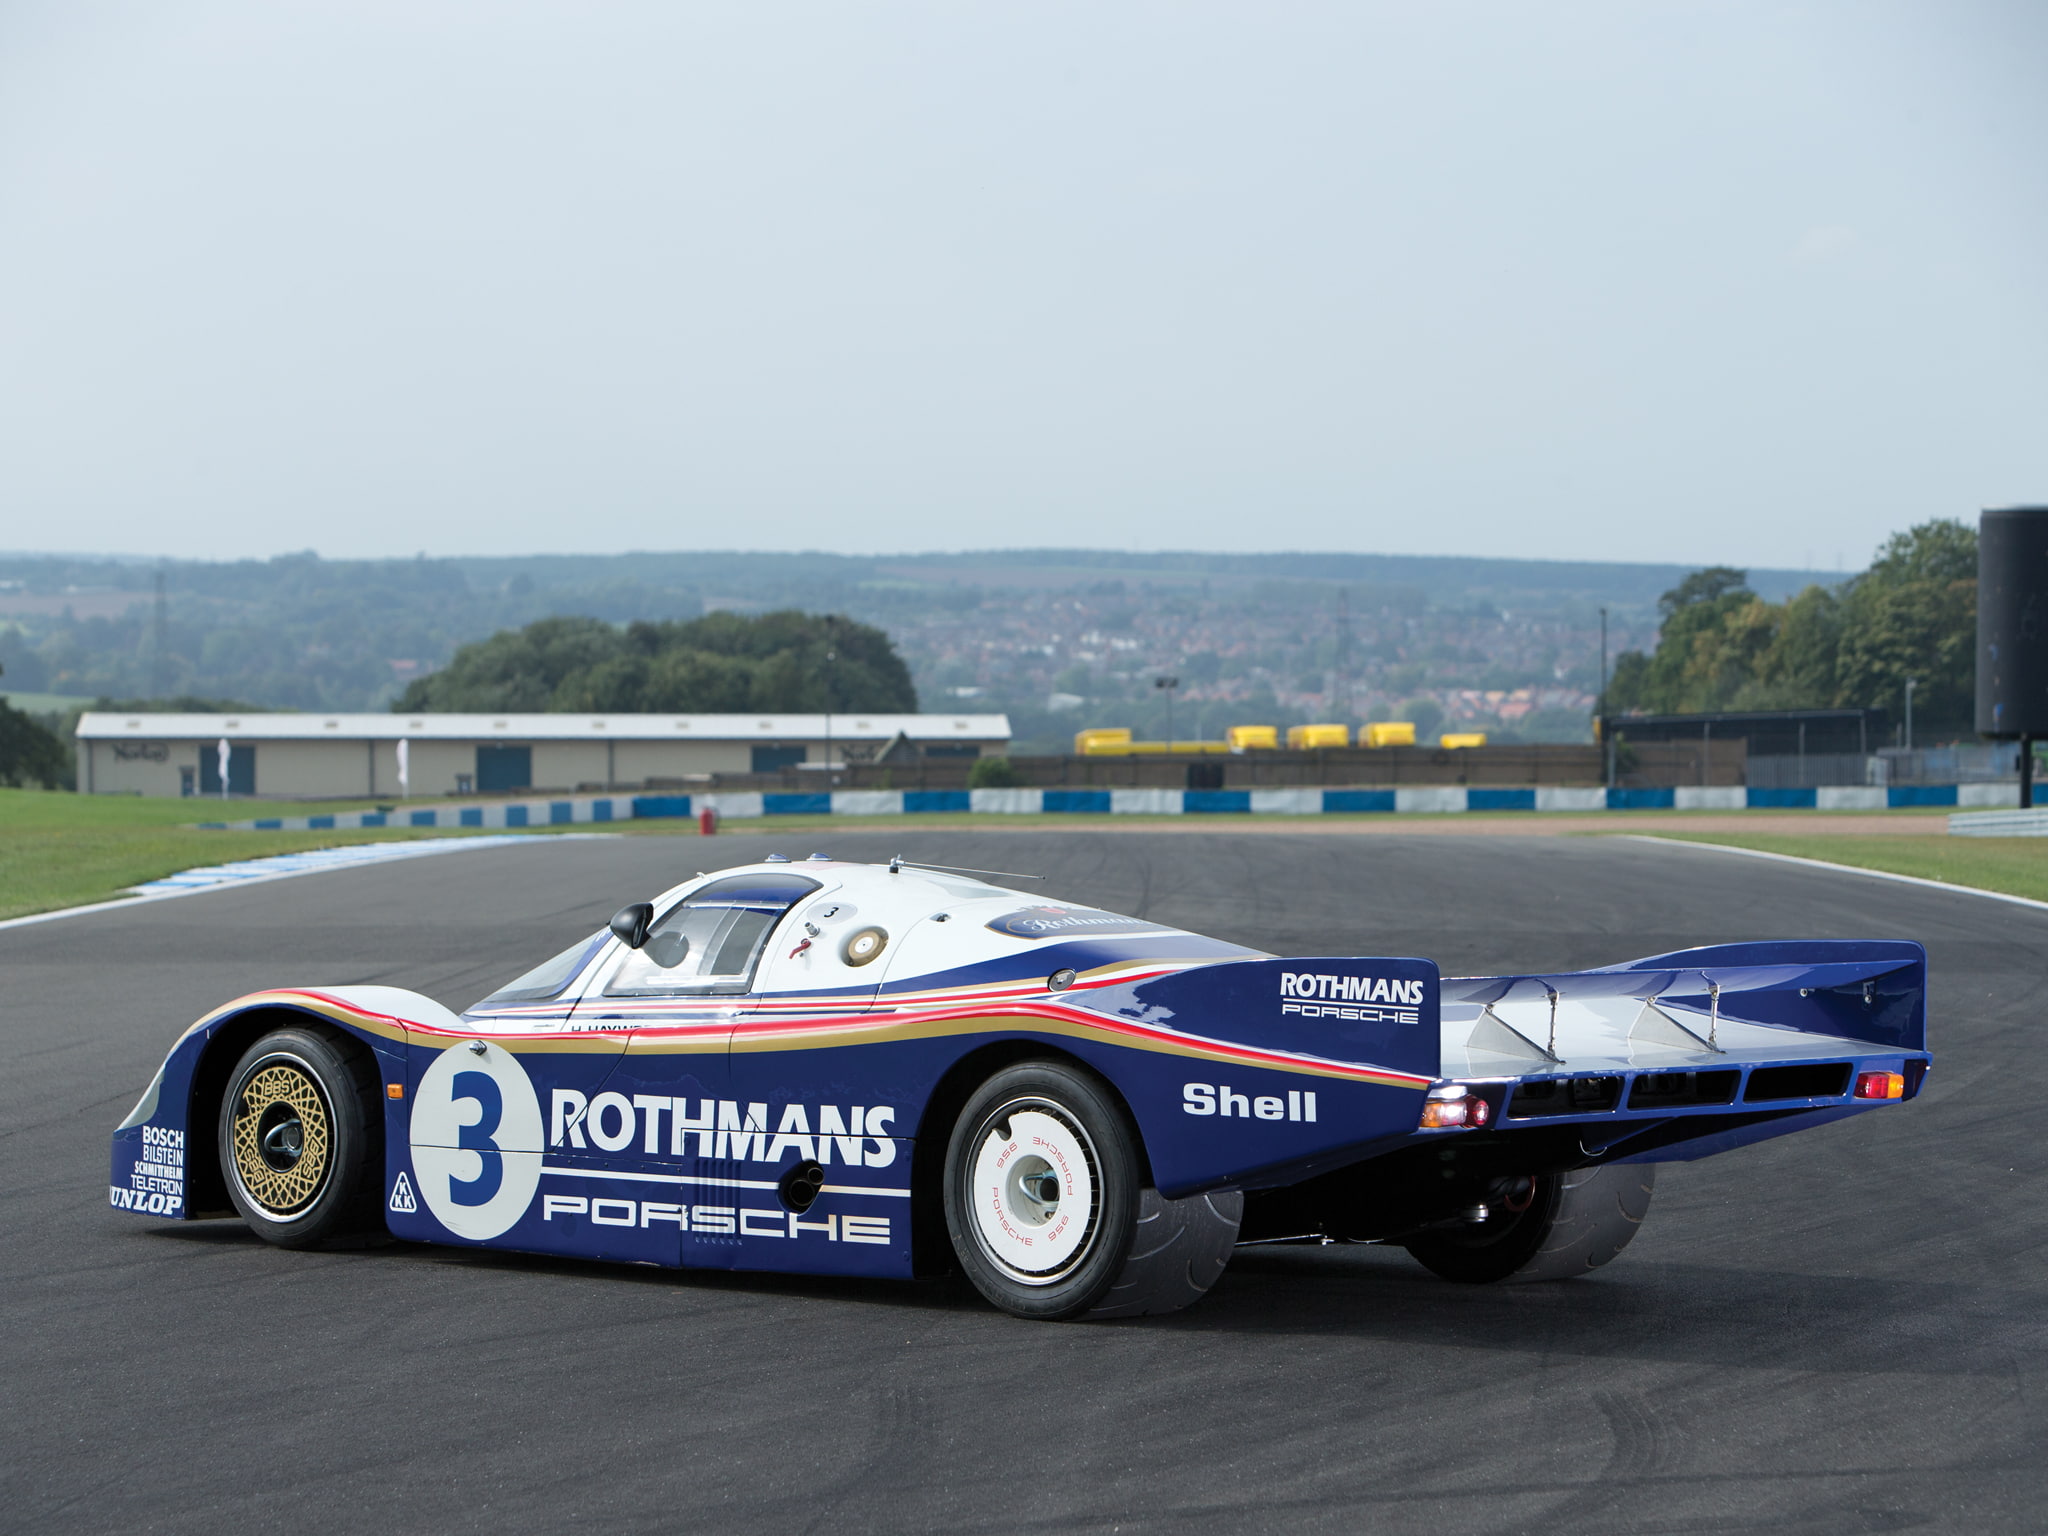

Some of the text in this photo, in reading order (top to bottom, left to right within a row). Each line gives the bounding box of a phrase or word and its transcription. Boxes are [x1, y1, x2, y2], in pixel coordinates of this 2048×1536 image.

[823, 906, 840, 918] 3
[1279, 972, 1424, 1005] ROTHMANS
[1282, 1003, 1419, 1025] PORSCHE
[264, 1080, 290, 1095] BBS
[1182, 1082, 1317, 1123] Shell
[142, 1125, 184, 1149] BOSCH
[448, 1070, 504, 1208] 3
[550, 1088, 897, 1168] ROTHMANS
[142, 1144, 184, 1167] BILSTEIN
[244, 1148, 265, 1182] BBS
[302, 1139, 320, 1179] BBS
[996, 1141, 1018, 1168] 956
[1031, 1136, 1073, 1196] PORSCHE
[109, 1184, 183, 1215] UNLOP
[130, 1173, 183, 1196] TELETRON
[543, 1194, 891, 1245] PORSCHE
[992, 1187, 1033, 1246] PORSCHE
[1047, 1214, 1069, 1242] 956
